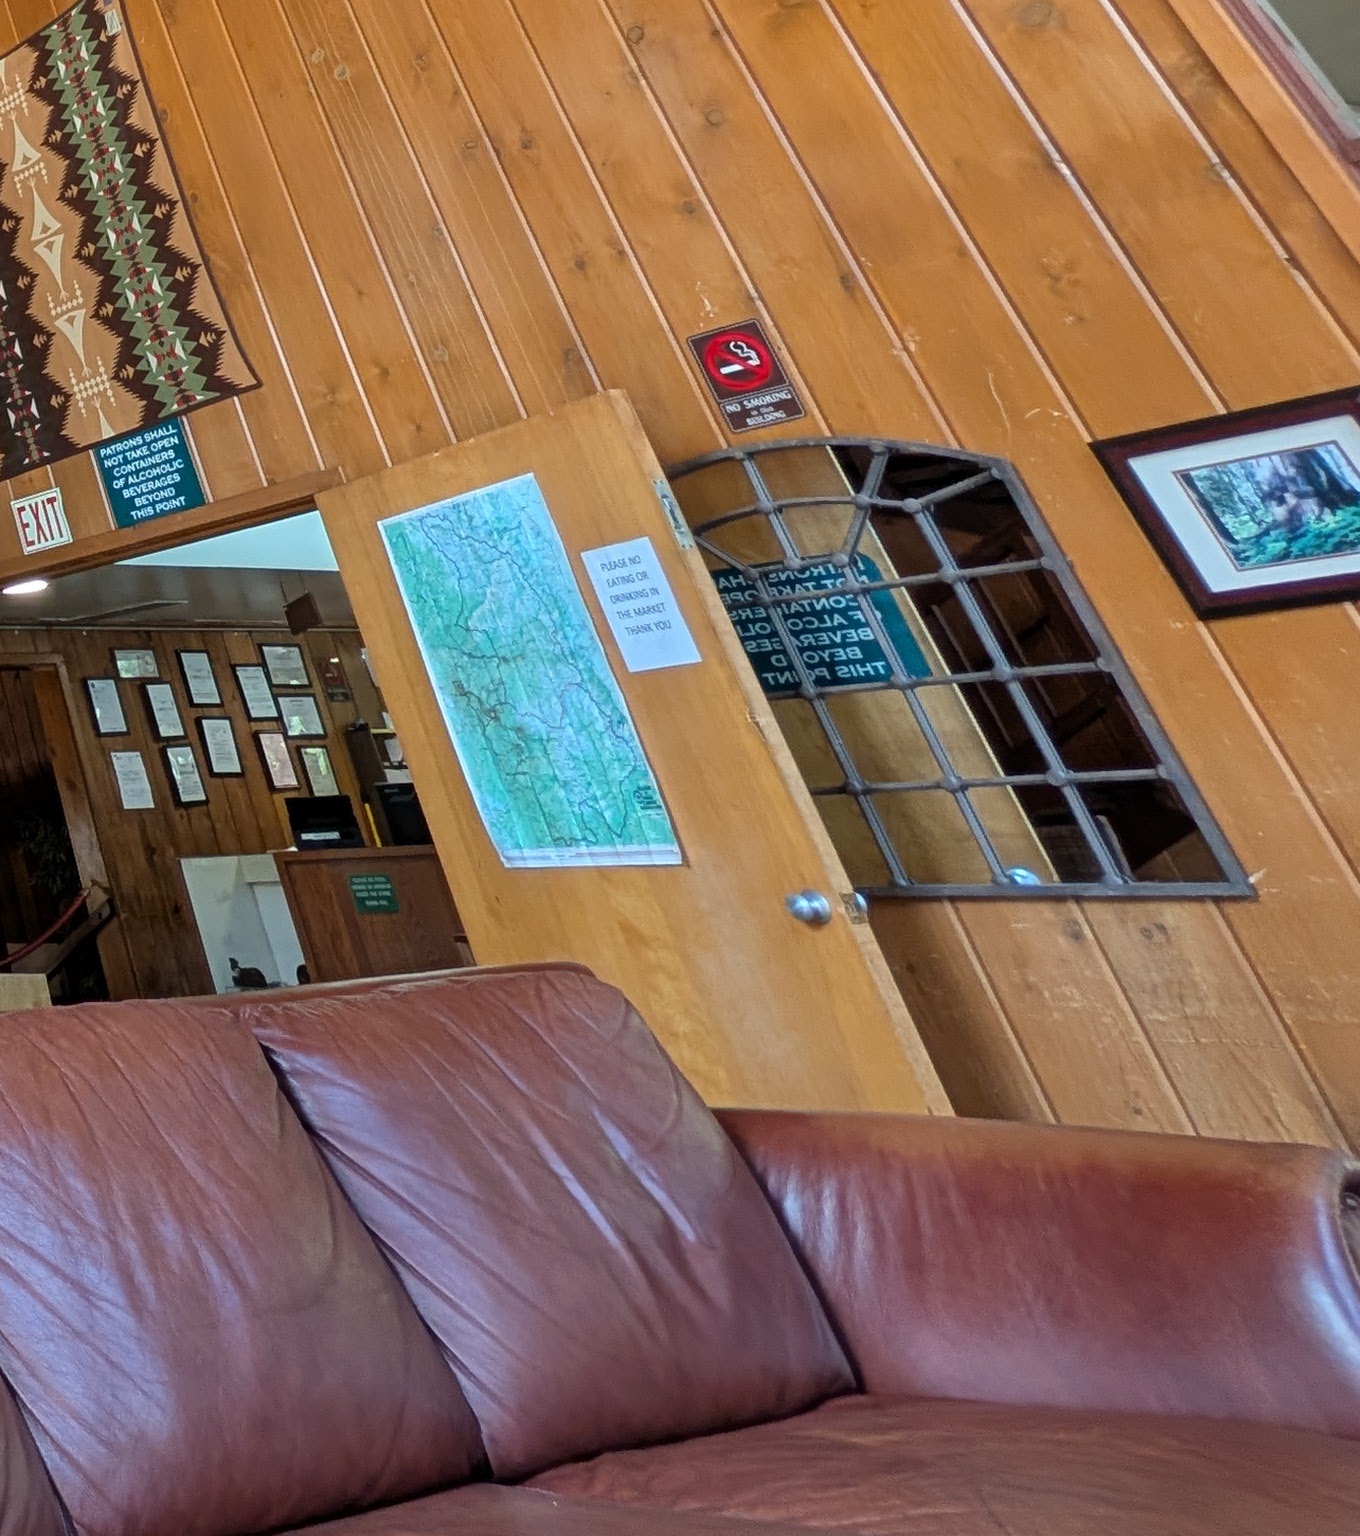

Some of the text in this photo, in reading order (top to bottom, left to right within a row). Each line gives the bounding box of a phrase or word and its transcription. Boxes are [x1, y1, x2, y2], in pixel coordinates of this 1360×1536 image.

[725, 391, 791, 414] NO SMOKING
[746, 410, 786, 425] BUILDING
[100, 424, 178, 458] PATRONS SHALL
[104, 435, 179, 468] NOT TAKE OPEN
[113, 449, 176, 477] CONTAINERS
[113, 458, 185, 489] OF ALCOHOLIC
[122, 472, 180, 499] BEVERAGES
[134, 487, 176, 507] BEYOND
[130, 496, 186, 520] THIS POINT
[17, 497, 63, 547] EXIT
[600, 554, 641, 572] PLEASE NO
[606, 570, 650, 588] EATING OR
[610, 586, 660, 604] DRINKING IN
[616, 602, 666, 620] THE MARKET
[625, 619, 672, 636] THANK YOU
